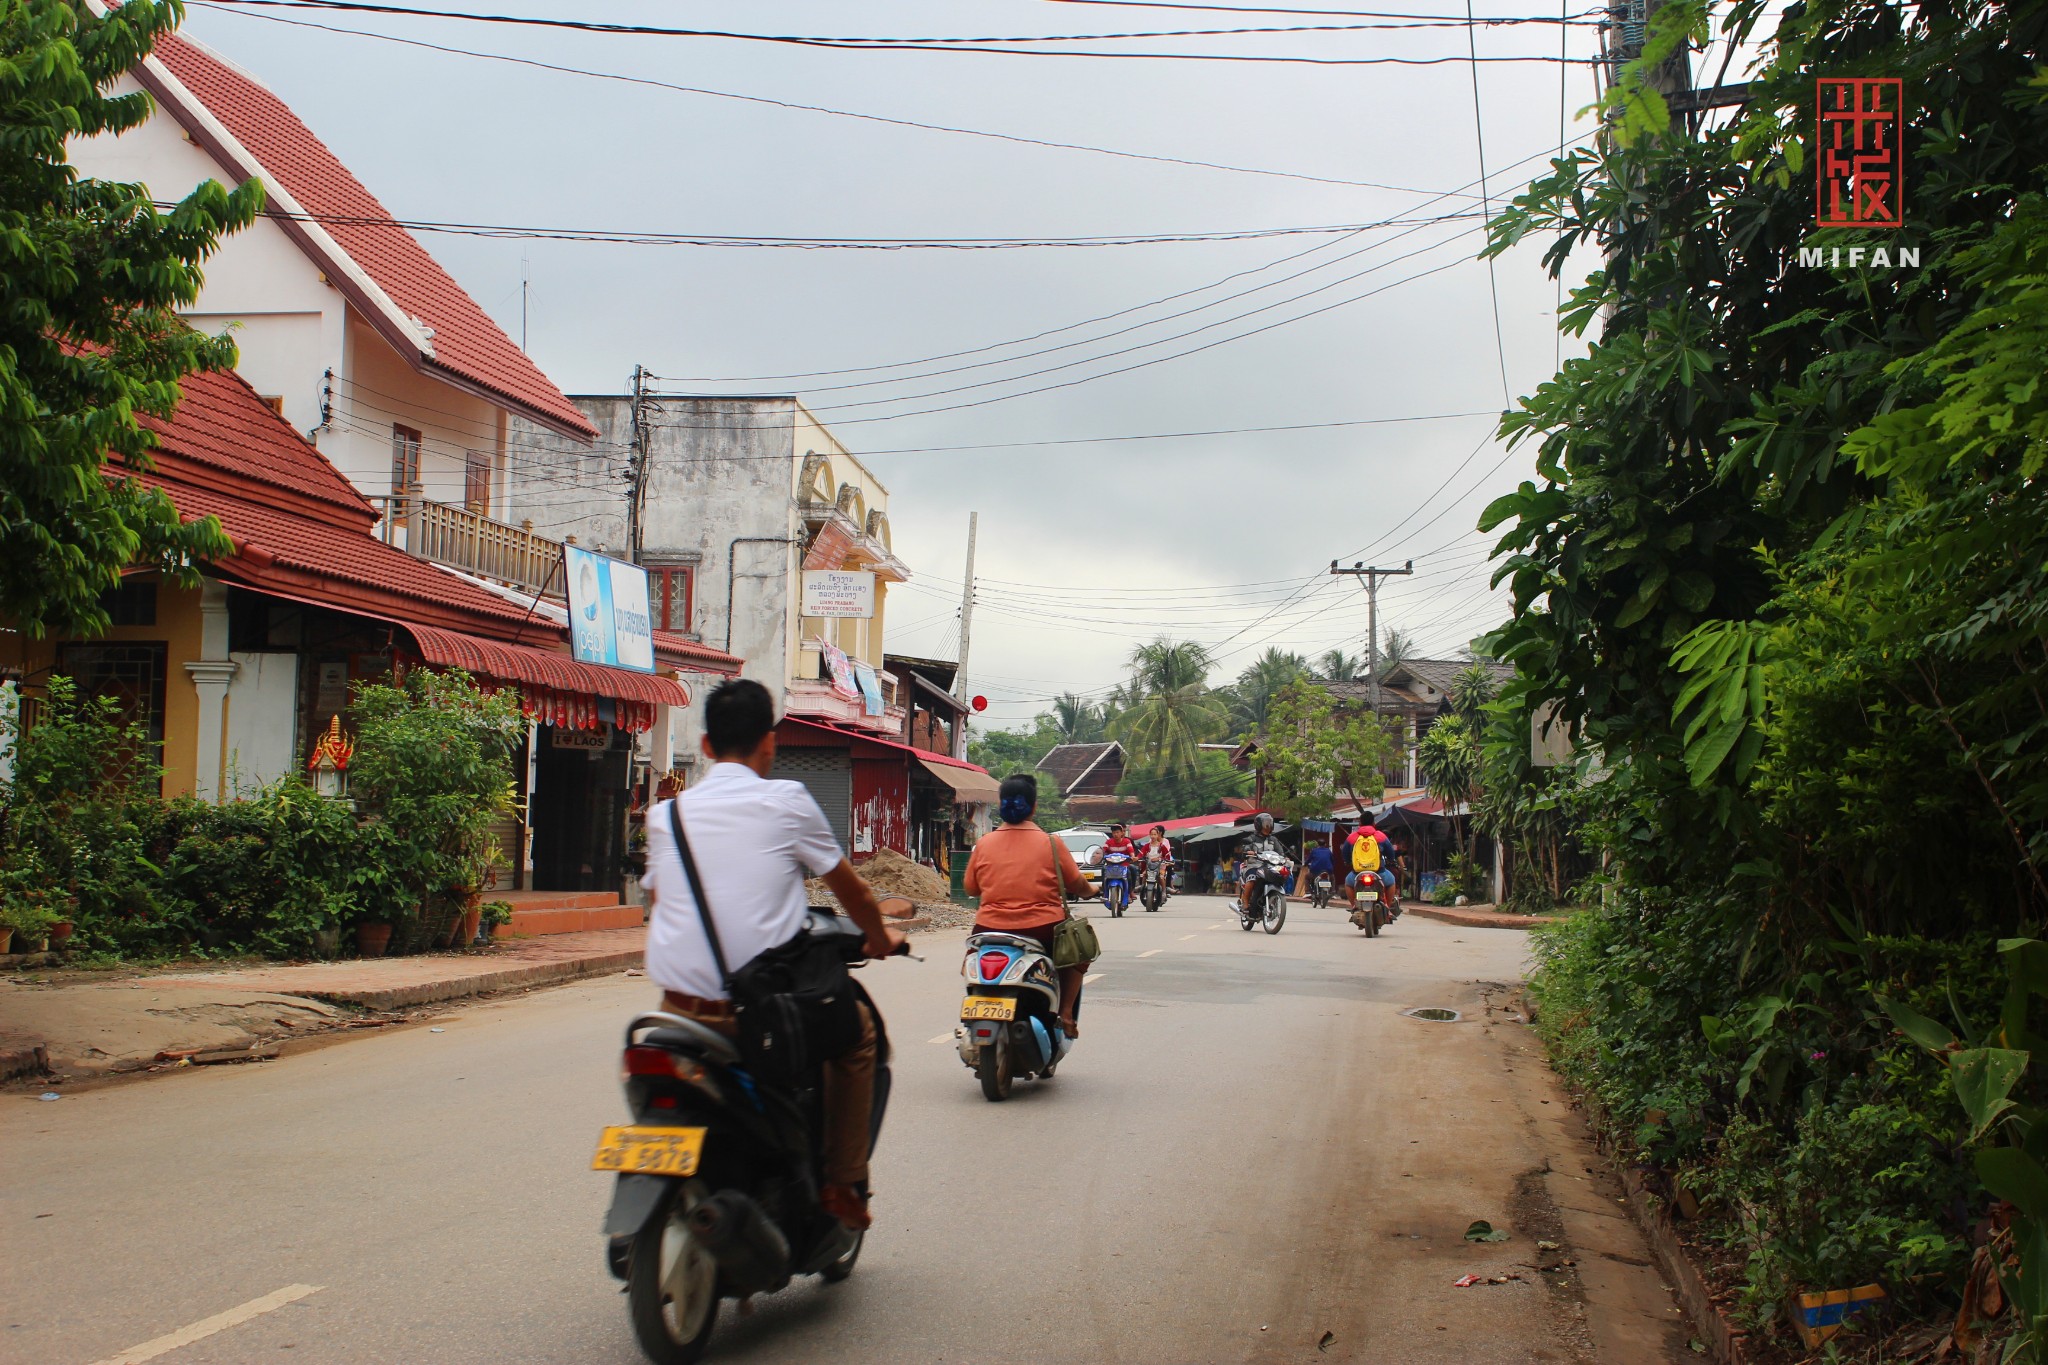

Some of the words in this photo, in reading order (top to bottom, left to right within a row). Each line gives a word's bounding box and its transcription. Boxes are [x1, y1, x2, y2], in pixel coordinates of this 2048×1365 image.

[580, 630, 608, 657] pepsi
[555, 736, 561, 745] I
[574, 737, 604, 747] LAOS
[983, 1007, 1011, 1018] 2709
